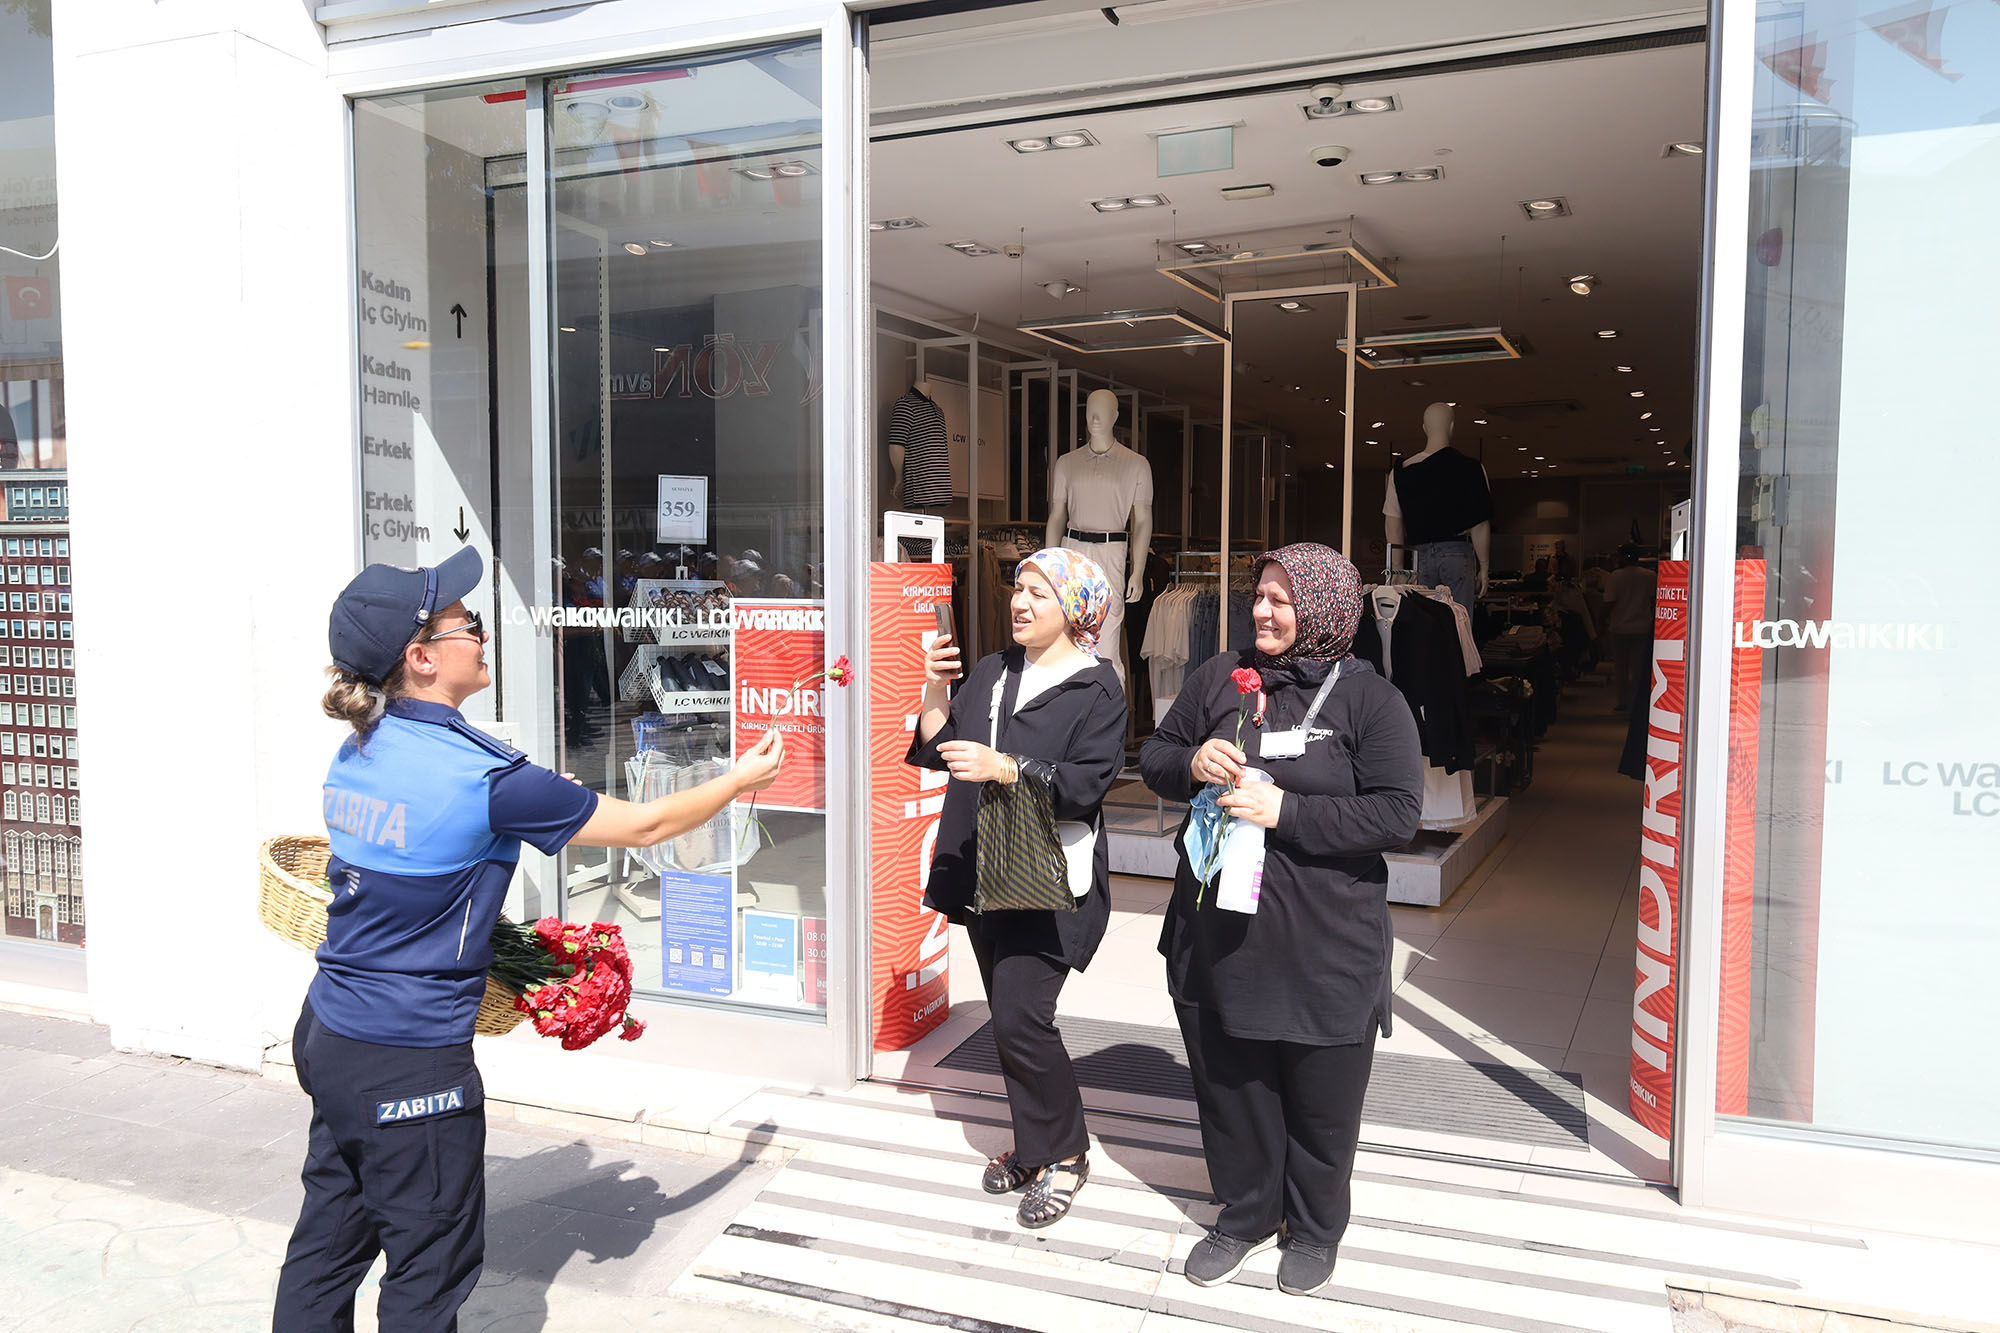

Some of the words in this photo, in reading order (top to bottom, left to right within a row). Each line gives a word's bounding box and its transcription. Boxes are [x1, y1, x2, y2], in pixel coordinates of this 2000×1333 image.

[361, 270, 411, 302] Kadın
[362, 353, 412, 381] Kadın
[364, 436, 413, 460] Erkek
[365, 491, 414, 512] Erkek
[902, 585, 935, 597] KIRMIZI
[741, 722, 769, 731] KIRMIZI
[770, 723, 806, 734] TİKETLİ
[1883, 761, 1929, 787] LC
[325, 787, 406, 849] ZABITA
[380, 1091, 461, 1119] ZABITA
